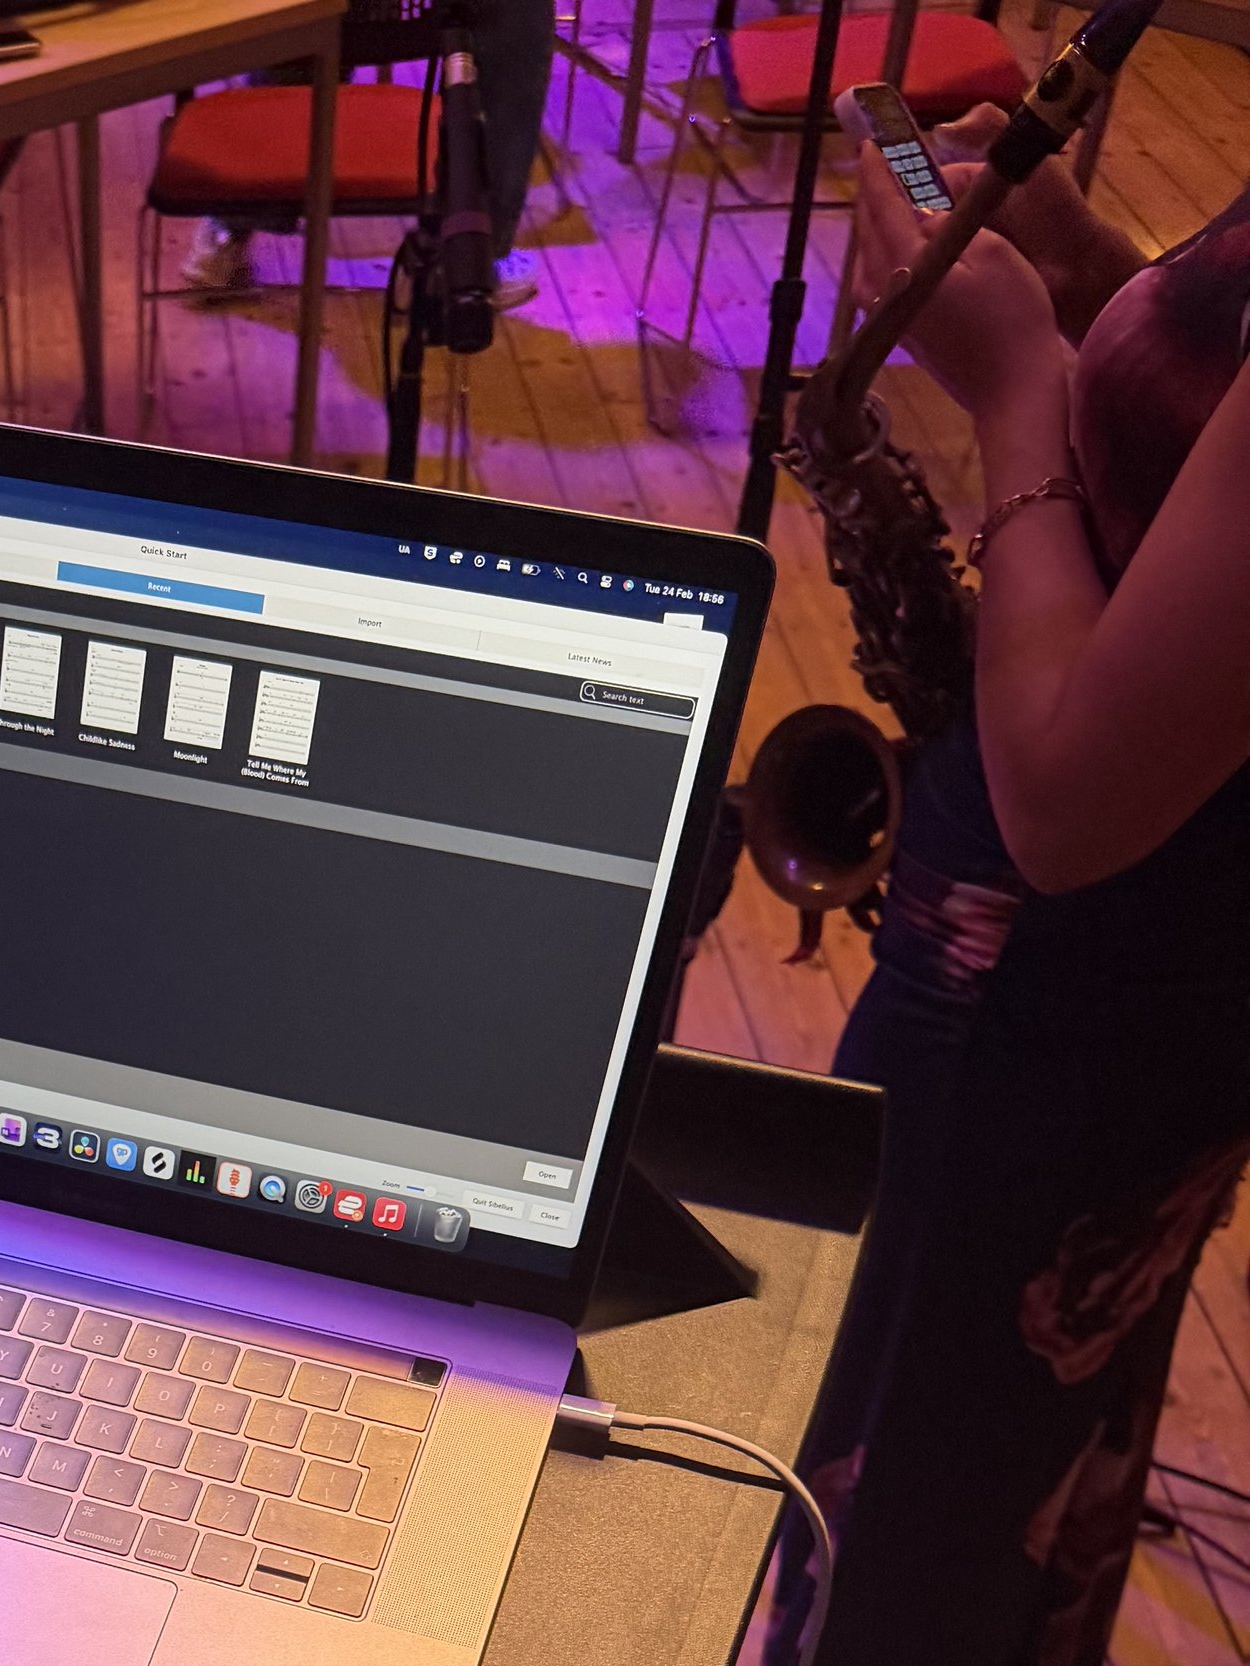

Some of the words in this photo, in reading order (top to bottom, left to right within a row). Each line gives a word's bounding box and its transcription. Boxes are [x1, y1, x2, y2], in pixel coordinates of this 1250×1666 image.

[140, 544, 162, 559] Quick
[164, 548, 188, 561] Start
[398, 545, 411, 555] UA
[147, 582, 171, 594] Recent
[644, 582, 661, 596] Tue
[663, 585, 676, 598] 24
[675, 587, 694, 600] Feb
[697, 590, 725, 605] 18:56
[357, 617, 382, 630] Import
[568, 651, 589, 666] Latest
[591, 655, 613, 668] News
[602, 689, 628, 705] Search
[630, 695, 645, 706] text
[24, 722, 35, 732] the
[36, 724, 55, 737] Night
[78, 733, 107, 747] Childlike
[108, 738, 136, 751] Sadness
[173, 750, 208, 765] Moonlight
[247, 760, 260, 769] Tell
[261, 762, 272, 771] Me
[272, 764, 295, 775] Where
[295, 767, 307, 778] My
[266, 772, 290, 784] Comes
[290, 776, 310, 788] From
[538, 1170, 557, 1181] Open
[382, 1179, 401, 1190] Zoom
[472, 1197, 487, 1208] Quit
[488, 1200, 514, 1212] Sibelius
[540, 1211, 560, 1221] Close
[40, 1321, 52, 1332] 7
[92, 1334, 104, 1346] 8
[0, 1349, 10, 1361] Y
[146, 1347, 158, 1359] 9
[50, 1363, 63, 1375] U
[201, 1360, 213, 1372] 0
[158, 1390, 171, 1401] O
[213, 1403, 226, 1414] P
[46, 1410, 58, 1421] J
[99, 1422, 112, 1435] K
[153, 1436, 165, 1450] L
[52, 1459, 68, 1473] M
[73, 1527, 123, 1547] command
[144, 1547, 176, 1562] option
